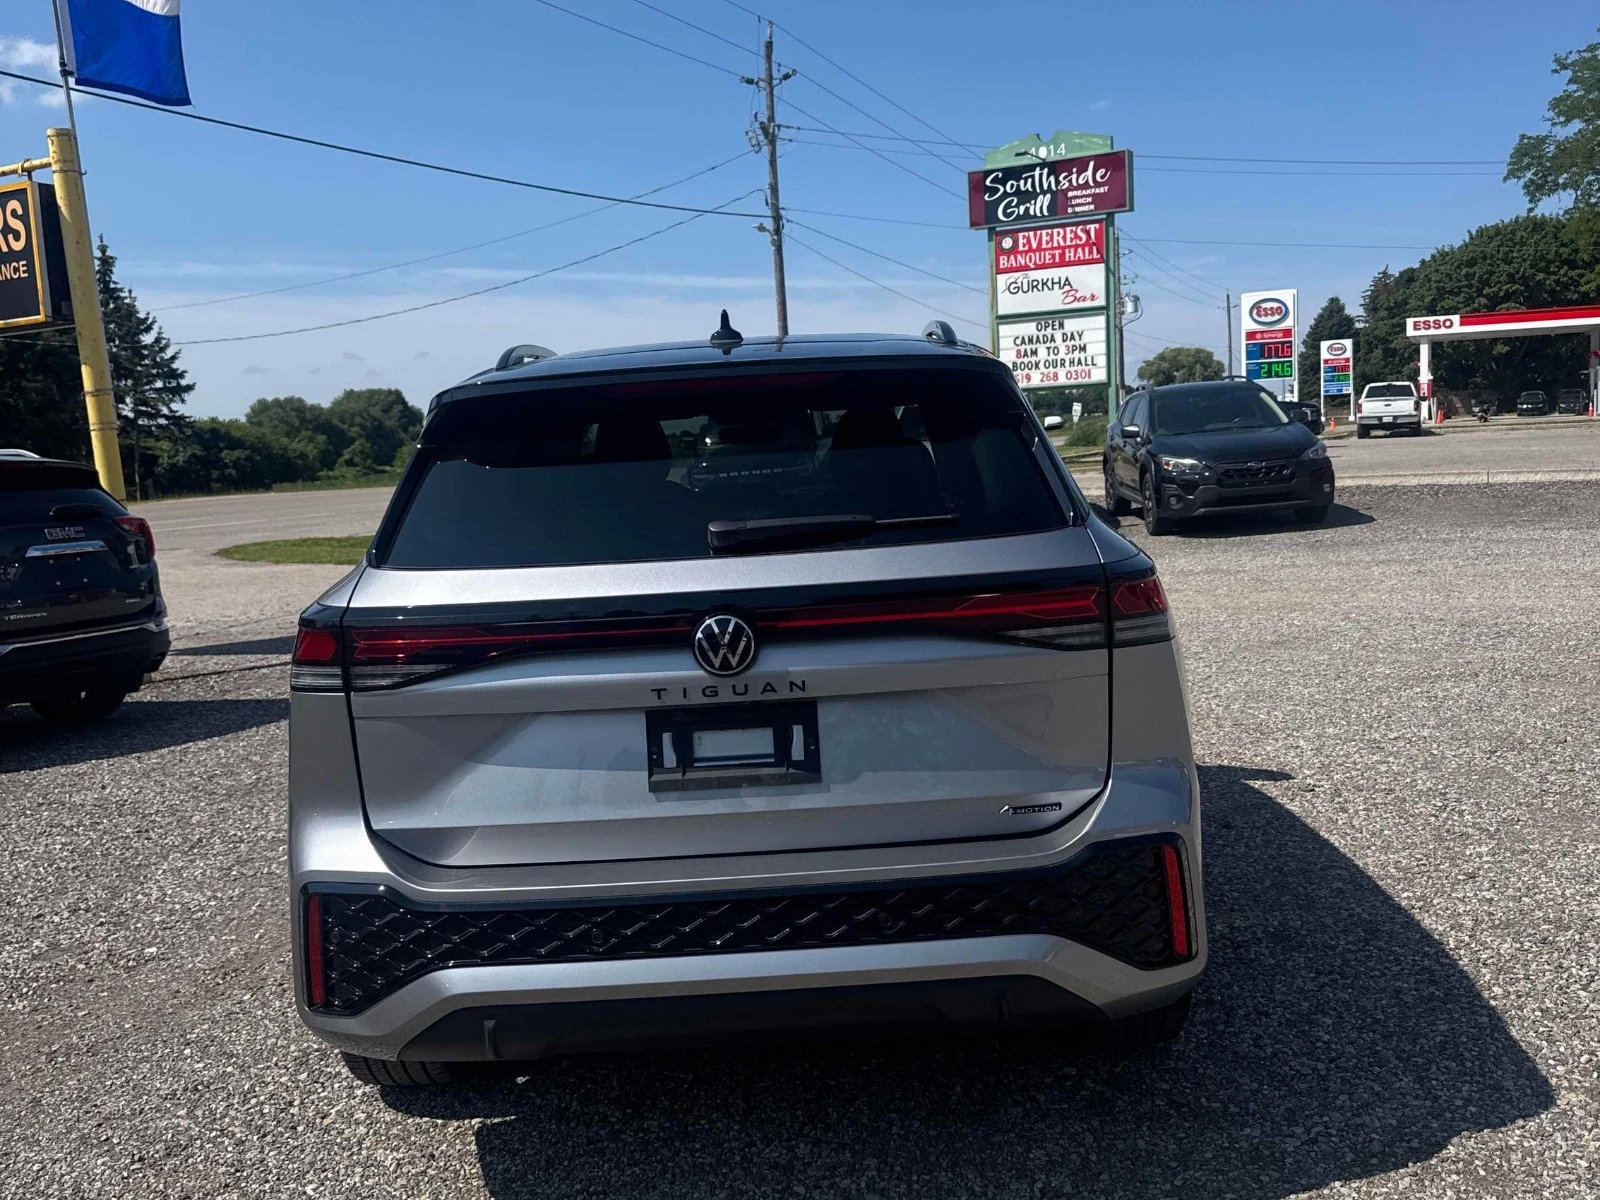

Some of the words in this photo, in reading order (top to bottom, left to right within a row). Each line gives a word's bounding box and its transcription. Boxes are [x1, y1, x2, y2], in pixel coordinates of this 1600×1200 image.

[1027, 143, 1066, 160] 4014
[984, 160, 1111, 201] Southside
[1067, 186, 1109, 198] BREAKFAST
[997, 194, 1051, 221] Grill
[1067, 196, 1092, 205] LUNCH
[1018, 223, 1099, 251] EVEREST
[1000, 250, 1061, 269] BANQUET
[1065, 246, 1101, 262] HALL
[0, 260, 28, 282] NCE
[1007, 276, 1074, 295] GURKHA
[1061, 288, 1099, 305] Bar
[1036, 320, 1065, 333] OPEN
[1412, 318, 1454, 332] ESSO
[1013, 333, 1056, 347] CANADA
[1062, 331, 1084, 343] DAY
[1015, 347, 1038, 359] 8AM
[1046, 346, 1060, 357] TO
[1064, 344, 1087, 355] 3PM
[1264, 343, 1291, 358] 177.6
[1012, 360, 1041, 372] BOOK
[1043, 358, 1066, 370] OUR
[1069, 356, 1098, 368] HALL
[1040, 371, 1059, 383] 268
[1065, 369, 1092, 381] 0301
[44, 526, 86, 540] GMC
[651, 680, 806, 700] TIGUAN
[1000, 804, 1060, 816] 4MOTION
